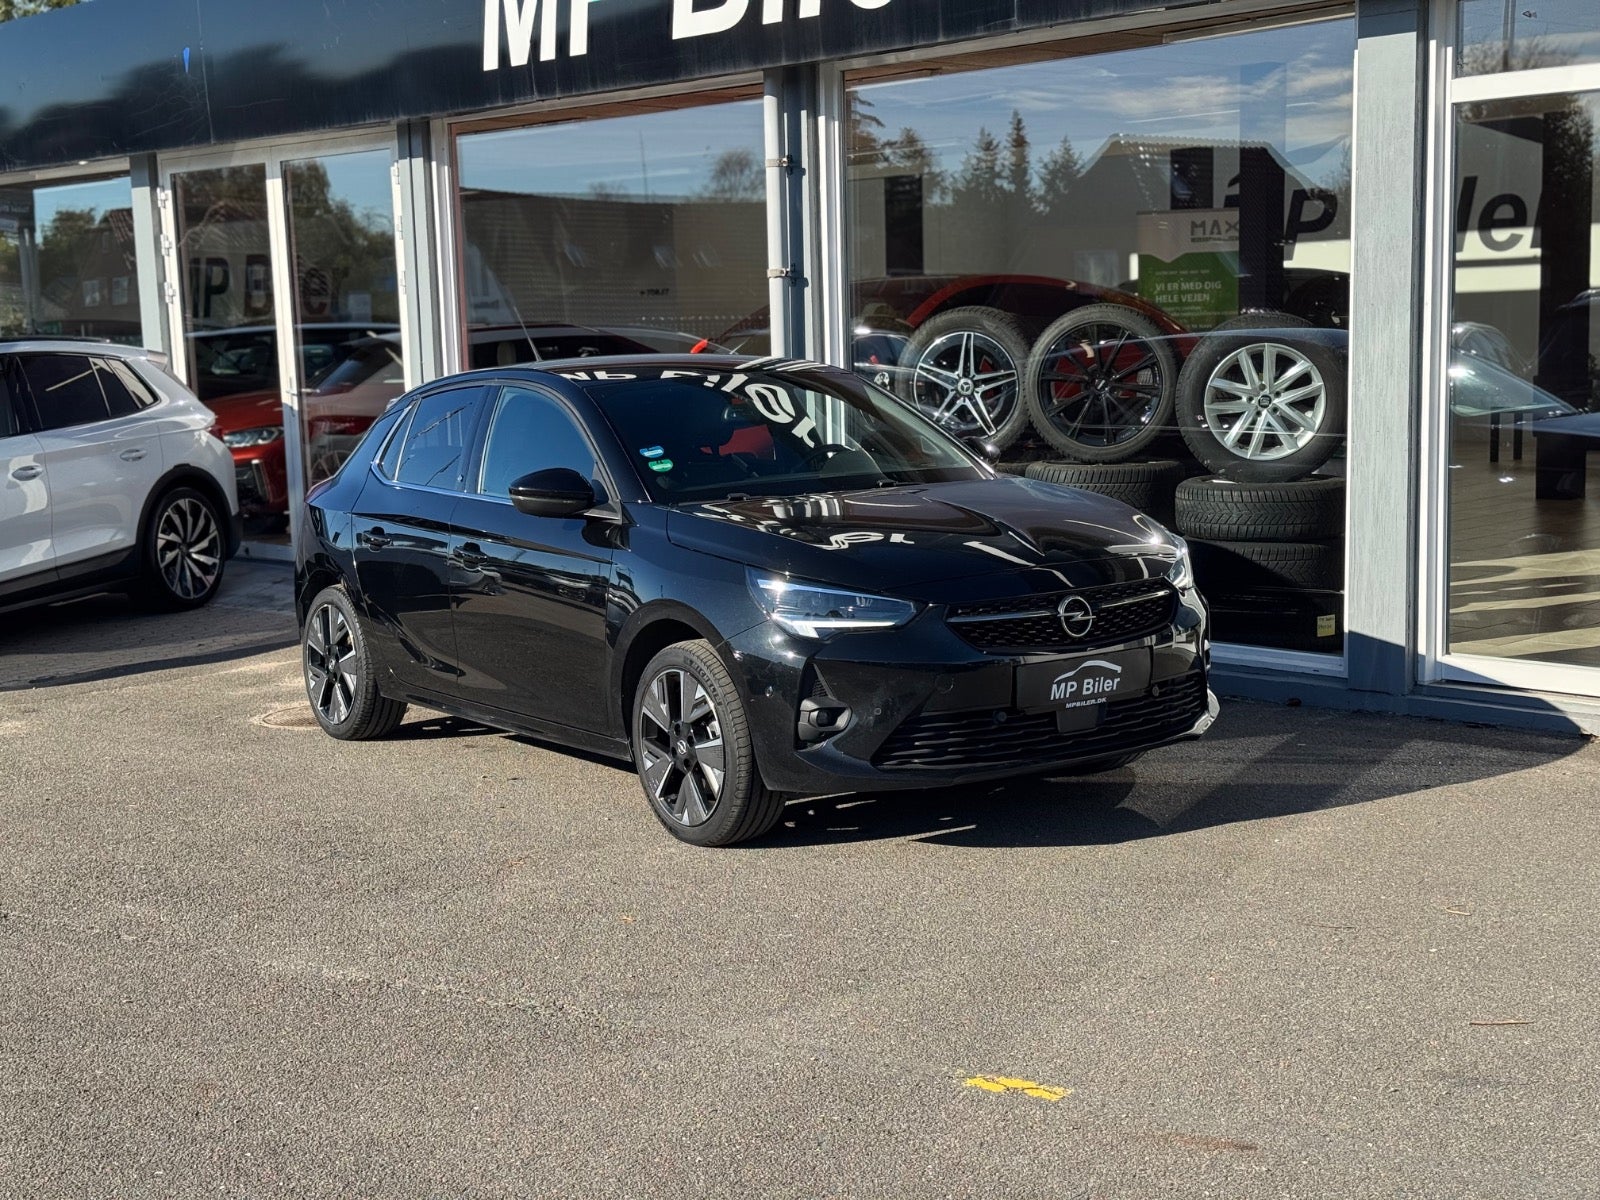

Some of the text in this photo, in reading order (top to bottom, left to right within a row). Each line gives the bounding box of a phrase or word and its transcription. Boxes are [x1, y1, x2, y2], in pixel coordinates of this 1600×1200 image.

[1181, 281, 1202, 290] MED
[1204, 280, 1222, 290] DIG
[1050, 676, 1120, 700] MP Biler
[1065, 697, 1107, 709] MPBILER.DK
